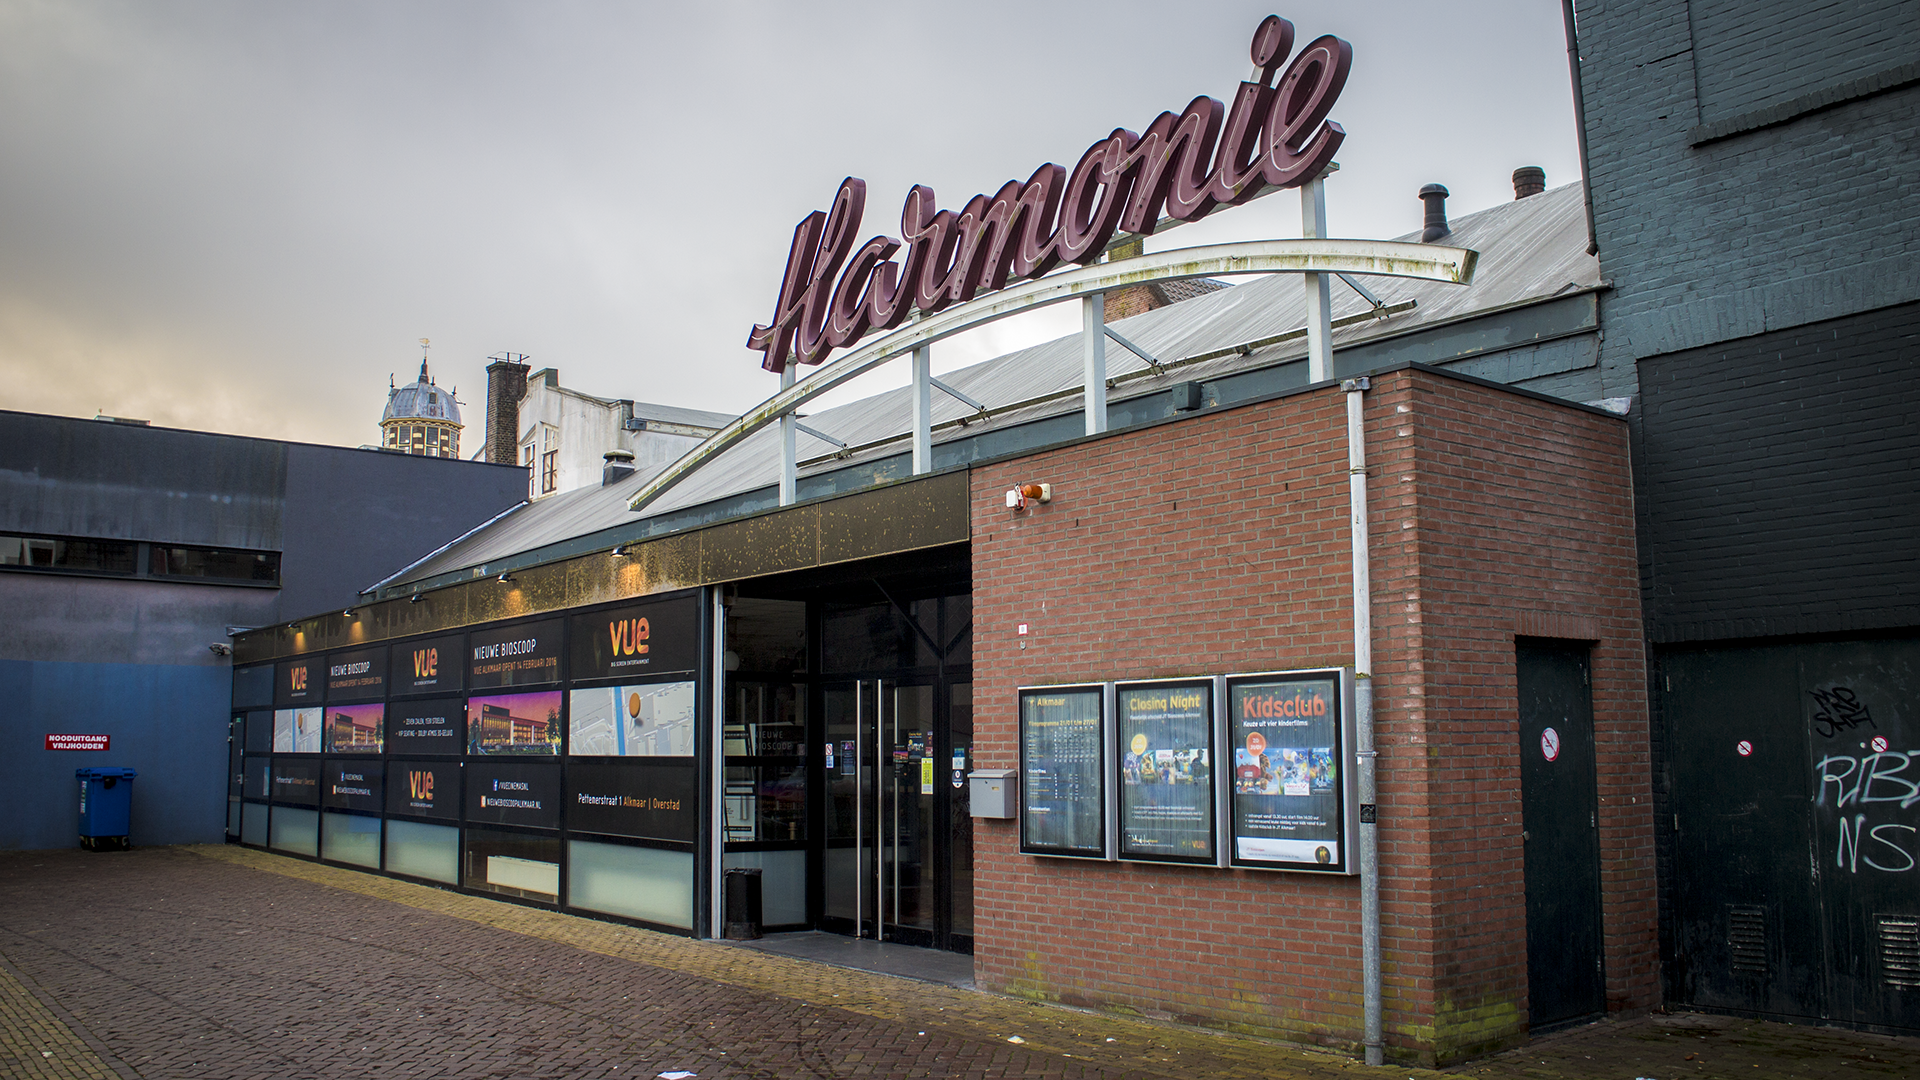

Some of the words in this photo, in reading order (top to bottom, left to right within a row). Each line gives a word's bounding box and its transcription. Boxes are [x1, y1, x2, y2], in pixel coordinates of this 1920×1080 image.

[746, 14, 1353, 374] Harmonie
[474, 644, 499, 660] NIEUWE
[501, 638, 537, 656] BIOSCOOP
[502, 661, 516, 672] OPENT
[522, 658, 545, 669] FEBRUARI
[546, 657, 557, 667] 2016
[1037, 698, 1065, 706] Alkmaar
[1130, 696, 1167, 712] Closing
[1170, 694, 1201, 711] Night
[1243, 694, 1325, 718] Kidsclub
[619, 796, 622, 806] 1
[623, 796, 646, 808] Alkmaar
[653, 798, 680, 811] Overstad
